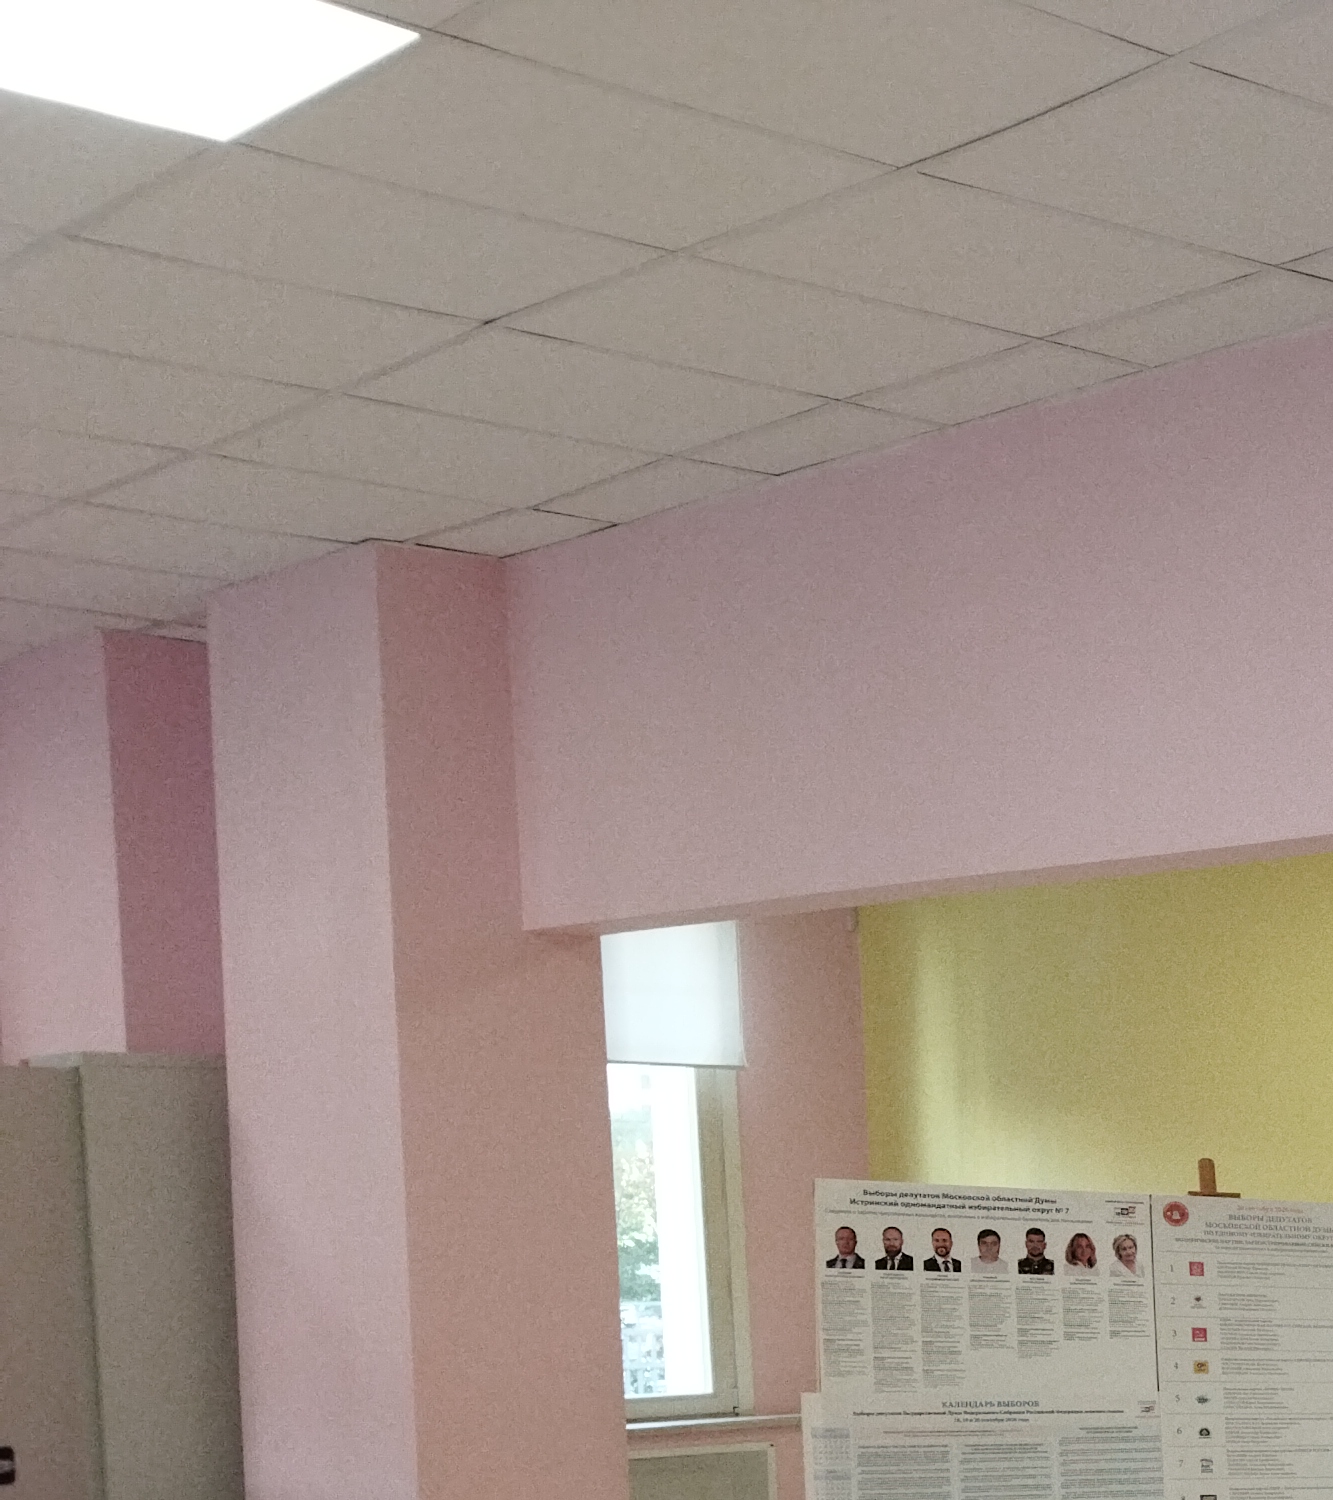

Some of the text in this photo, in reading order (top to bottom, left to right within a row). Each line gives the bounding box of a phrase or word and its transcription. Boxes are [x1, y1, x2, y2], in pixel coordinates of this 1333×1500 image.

[863, 1189, 1057, 1205] Выборы депутатов Московской областной Думы
[849, 1198, 899, 1207] Истринский
[900, 1201, 966, 1210] одномандатный
[968, 1203, 1030, 1212] избирательный
[1031, 1207, 1053, 1215] округ
[941, 1400, 1040, 1408] КАЛЕНДАРЬ ВЫБОРОВ
